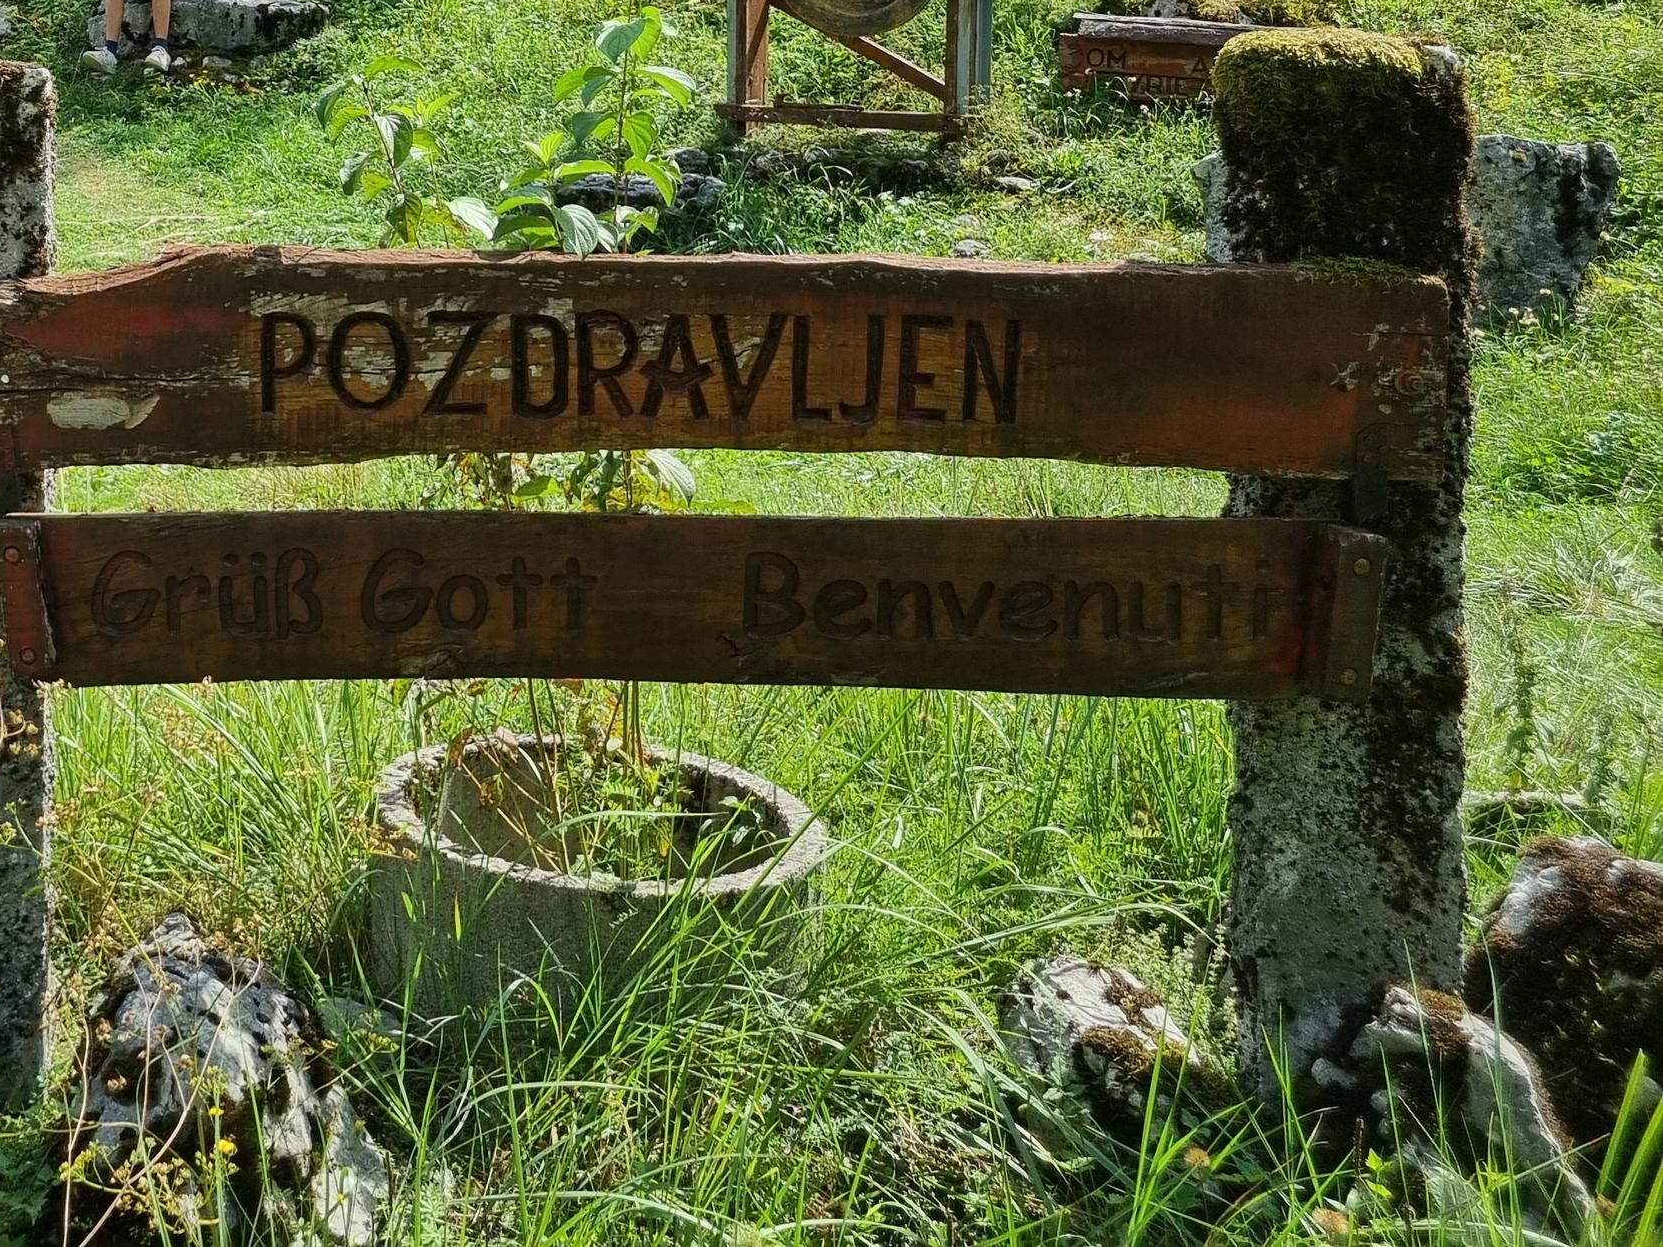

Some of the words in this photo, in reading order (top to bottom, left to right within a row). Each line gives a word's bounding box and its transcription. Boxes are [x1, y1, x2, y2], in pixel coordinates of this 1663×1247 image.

[260, 308, 1023, 426] POZDRAVLJEN
[90, 546, 325, 639] Grüß
[360, 547, 598, 635] Gott
[743, 552, 1273, 643] Benvenuti
